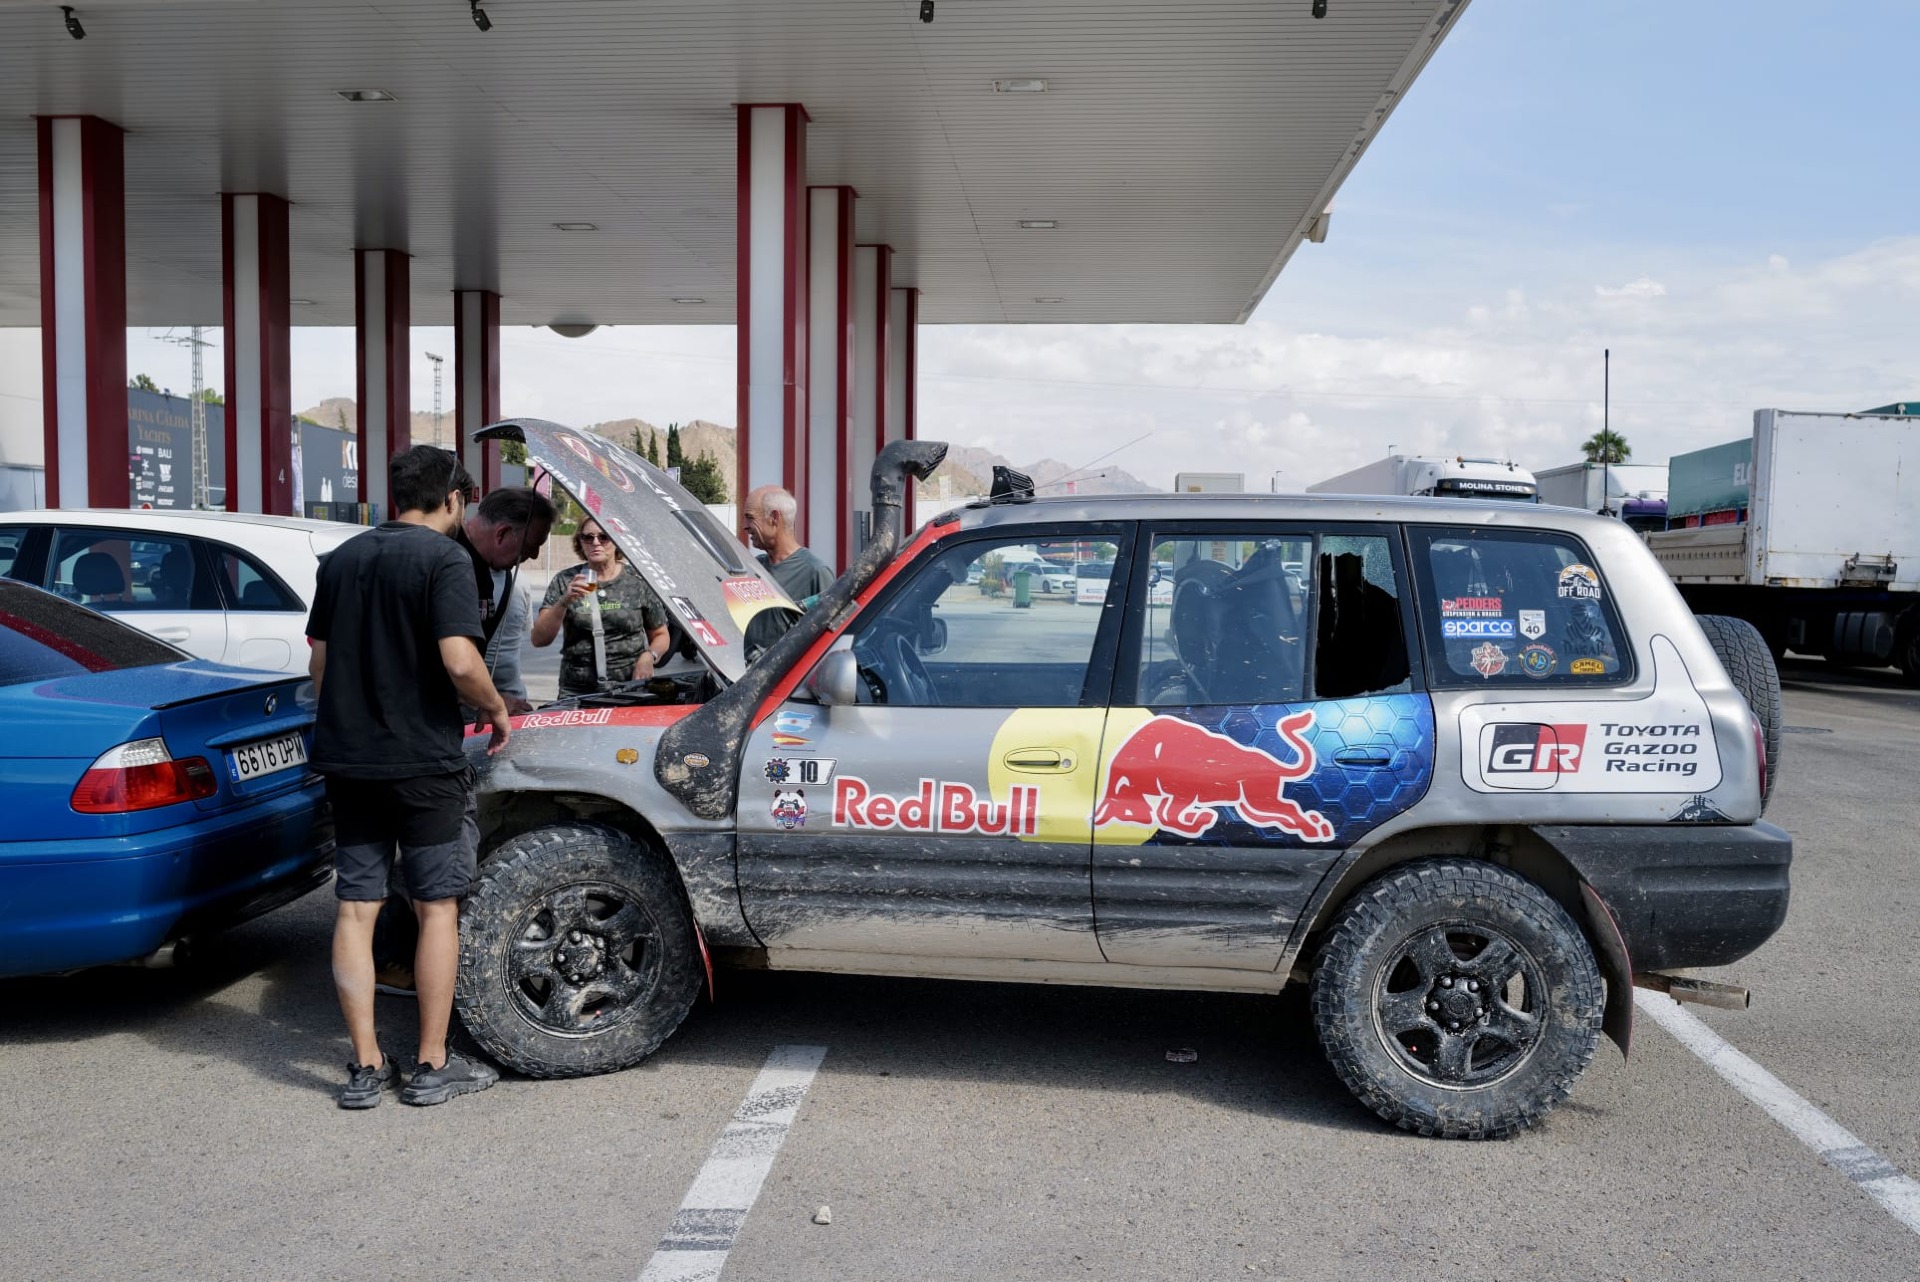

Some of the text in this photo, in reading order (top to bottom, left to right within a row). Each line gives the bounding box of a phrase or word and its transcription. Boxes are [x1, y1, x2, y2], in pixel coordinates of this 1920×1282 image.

[127, 408, 153, 423] ARINA
[157, 447, 172, 459] BALI
[278, 468, 285, 484] 4
[1459, 482, 1523, 492] MOLINA STONE
[1558, 586, 1600, 599] OFF ROAD
[1455, 597, 1502, 610] PEDDERS
[1444, 621, 1513, 637] sparco
[1525, 625, 1540, 634] 40
[1573, 660, 1603, 669] CAMEL
[522, 708, 613, 728] Red Bull
[1600, 723, 1700, 737] TOYOTA
[1604, 742, 1697, 755] GAZOO
[237, 742, 277, 775] 6616
[1492, 743, 1581, 770] GR
[799, 760, 818, 783] 10
[1606, 759, 1697, 776] Racing
[834, 776, 1039, 836] Red Bull
